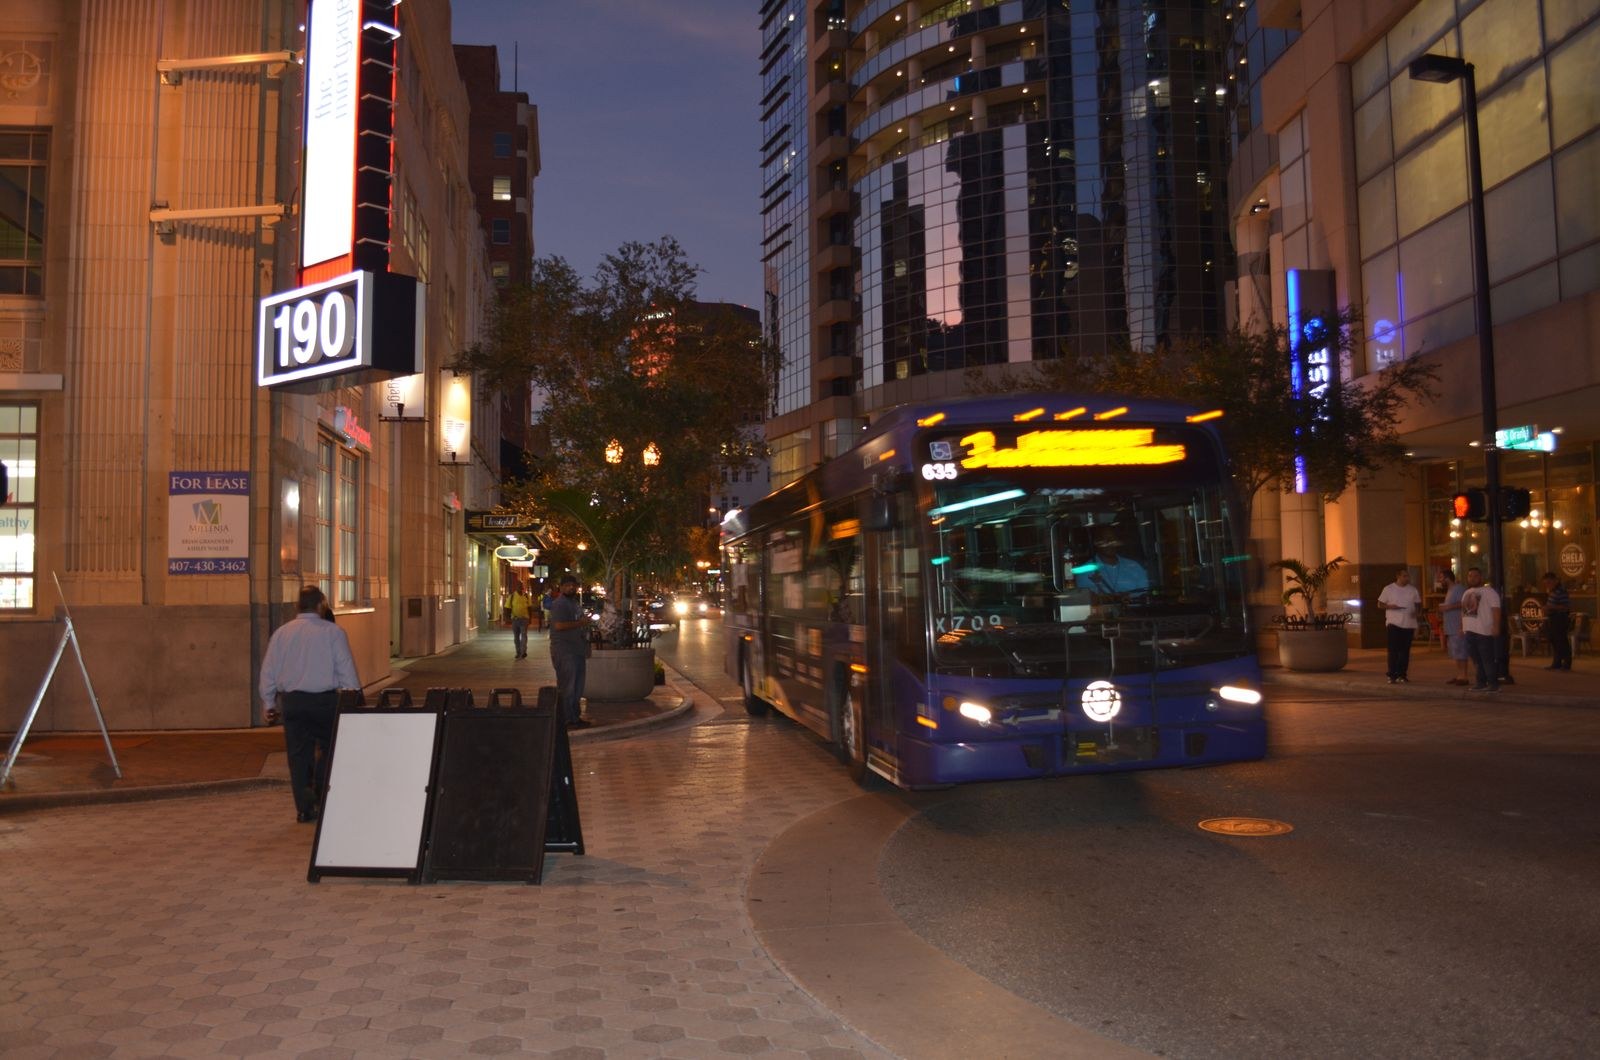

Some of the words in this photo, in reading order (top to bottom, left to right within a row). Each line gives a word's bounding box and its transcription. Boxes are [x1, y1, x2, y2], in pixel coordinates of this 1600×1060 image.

[273, 290, 347, 367] 190
[921, 462, 958, 480] 635
[1561, 552, 1584, 563] CHELA
[170, 561, 246, 571] 407-430-3462
[1521, 607, 1544, 618] CHELA
